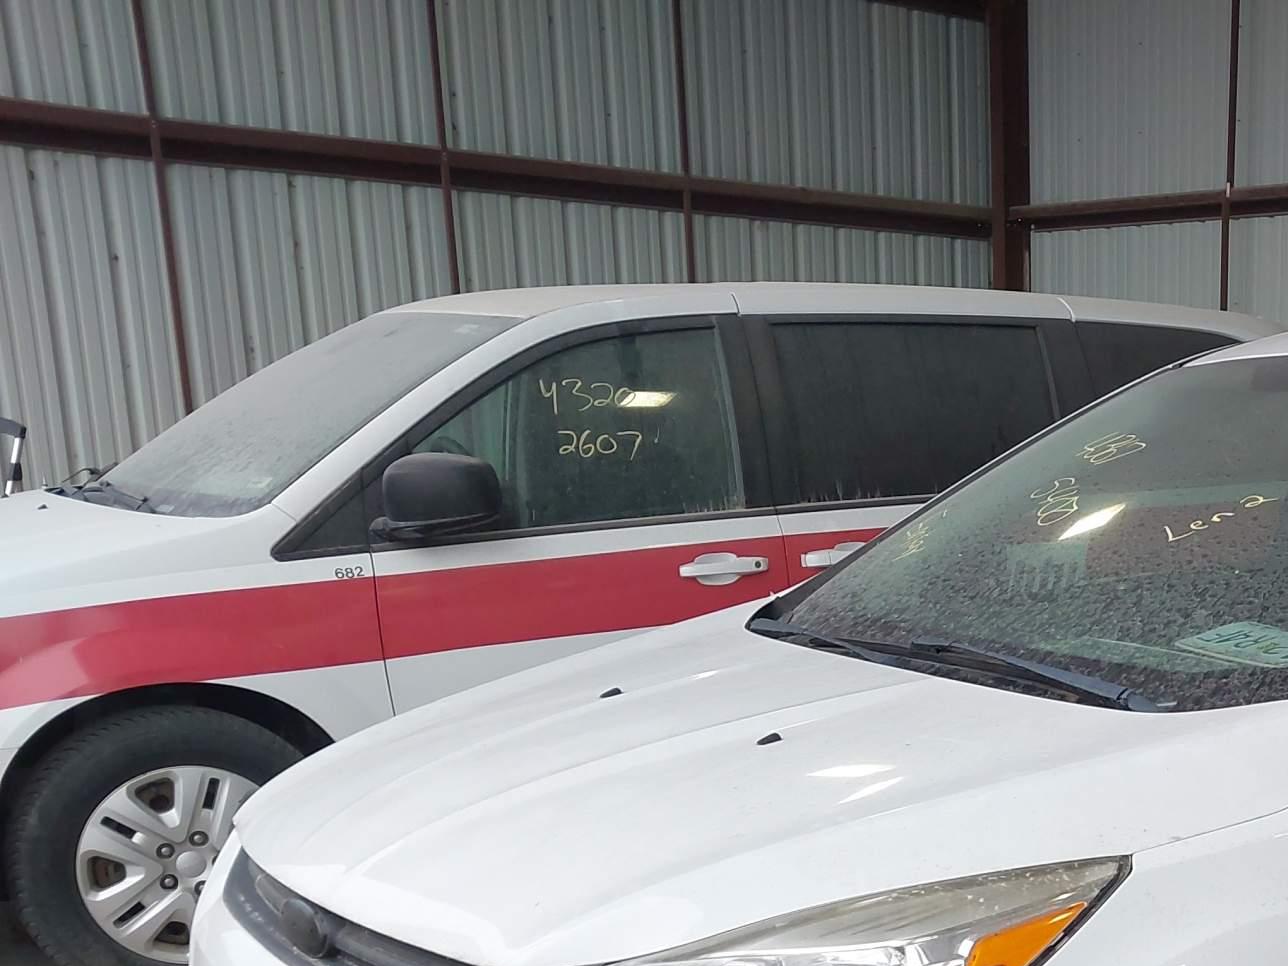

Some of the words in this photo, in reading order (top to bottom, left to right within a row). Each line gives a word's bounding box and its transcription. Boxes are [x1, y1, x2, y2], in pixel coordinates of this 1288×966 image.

[538, 378, 637, 415] 4320
[557, 430, 643, 461] 2607
[334, 565, 366, 579] 682
